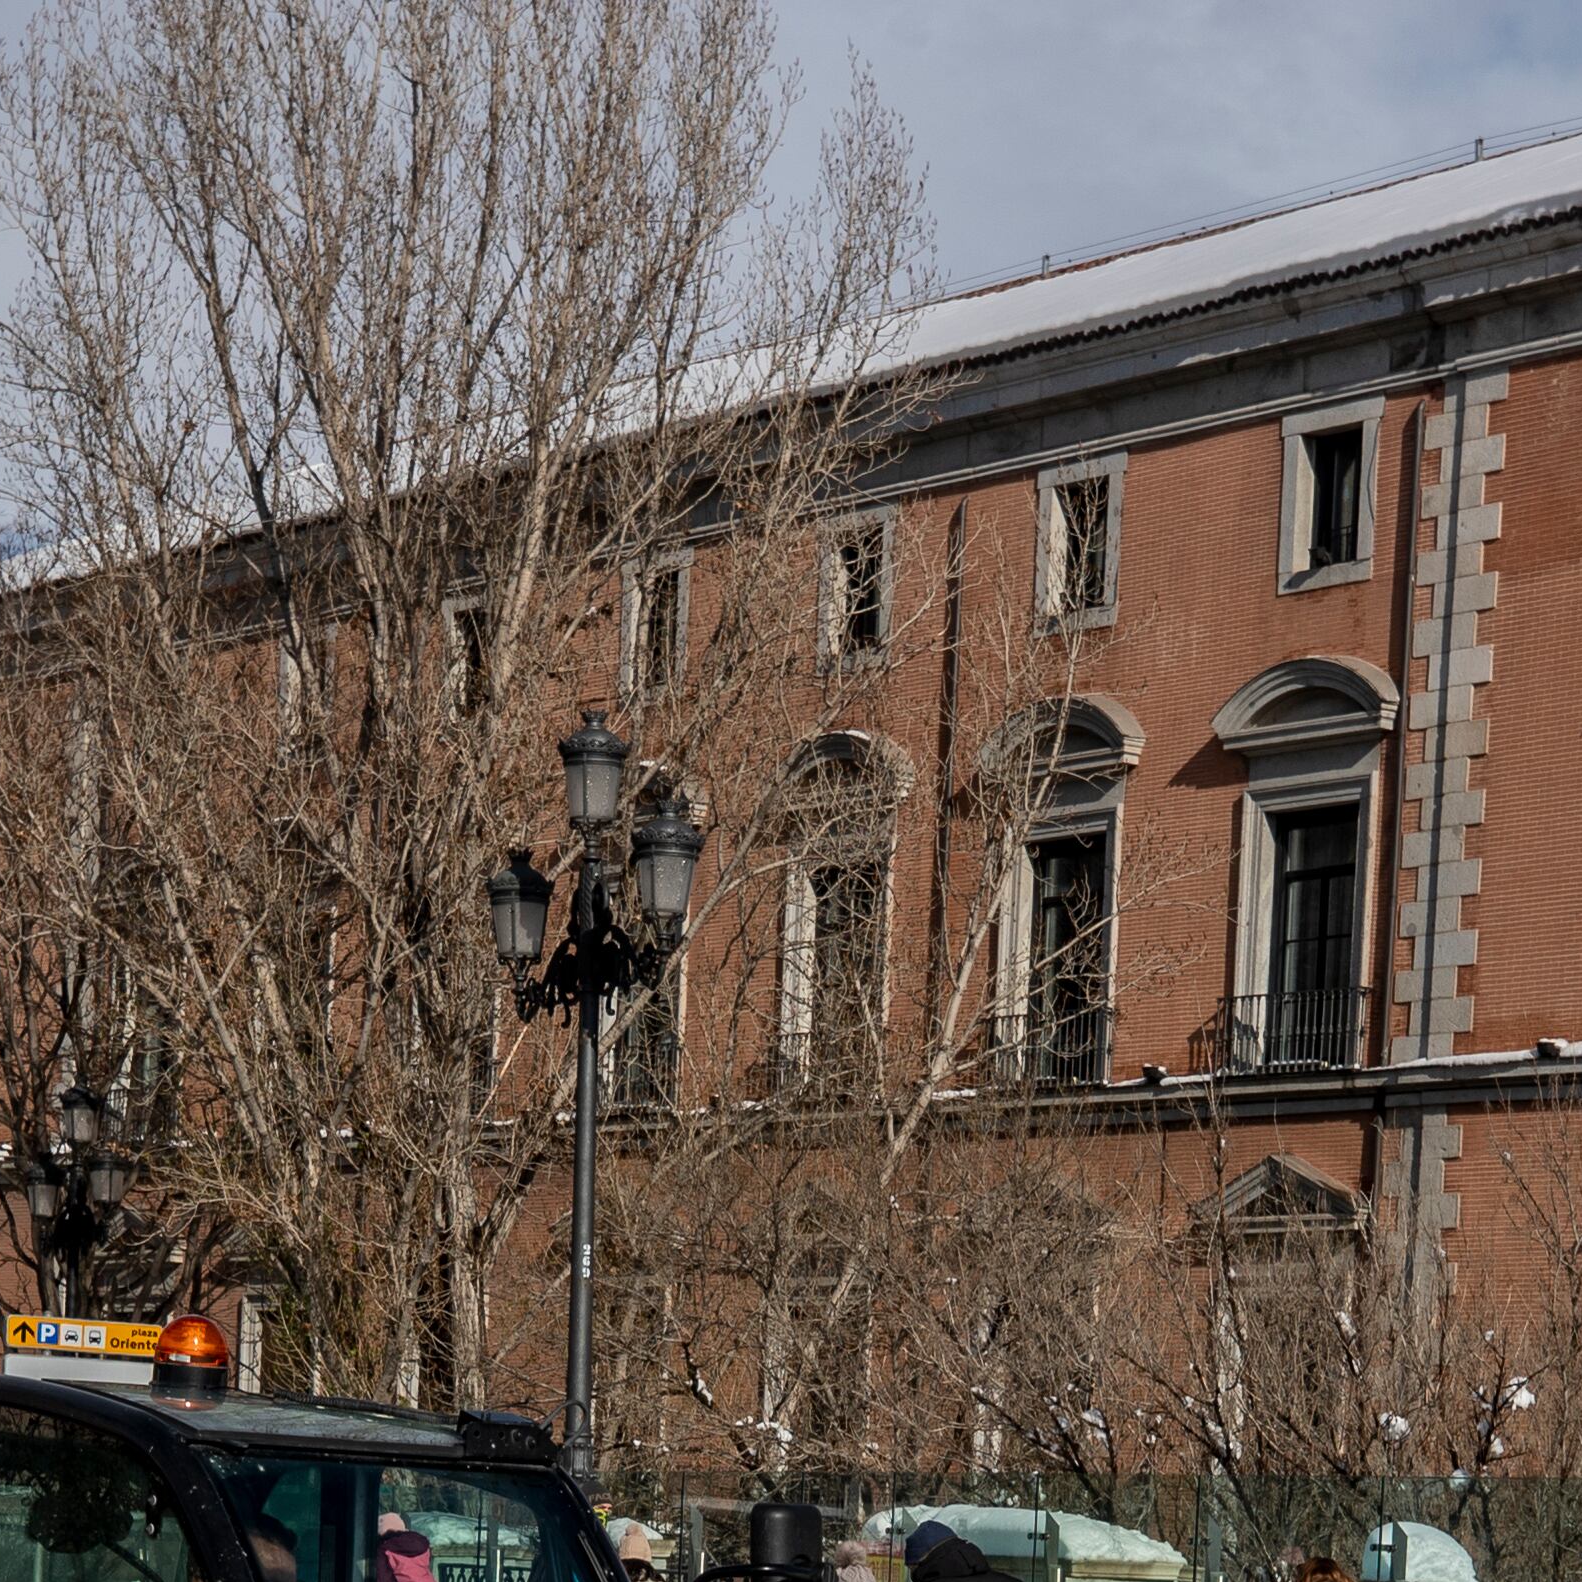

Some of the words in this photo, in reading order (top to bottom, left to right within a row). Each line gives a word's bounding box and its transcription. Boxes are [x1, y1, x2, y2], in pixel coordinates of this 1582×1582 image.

[582, 1243, 591, 1278] 269
[40, 1324, 55, 1342] P
[131, 1329, 158, 1337] plaza
